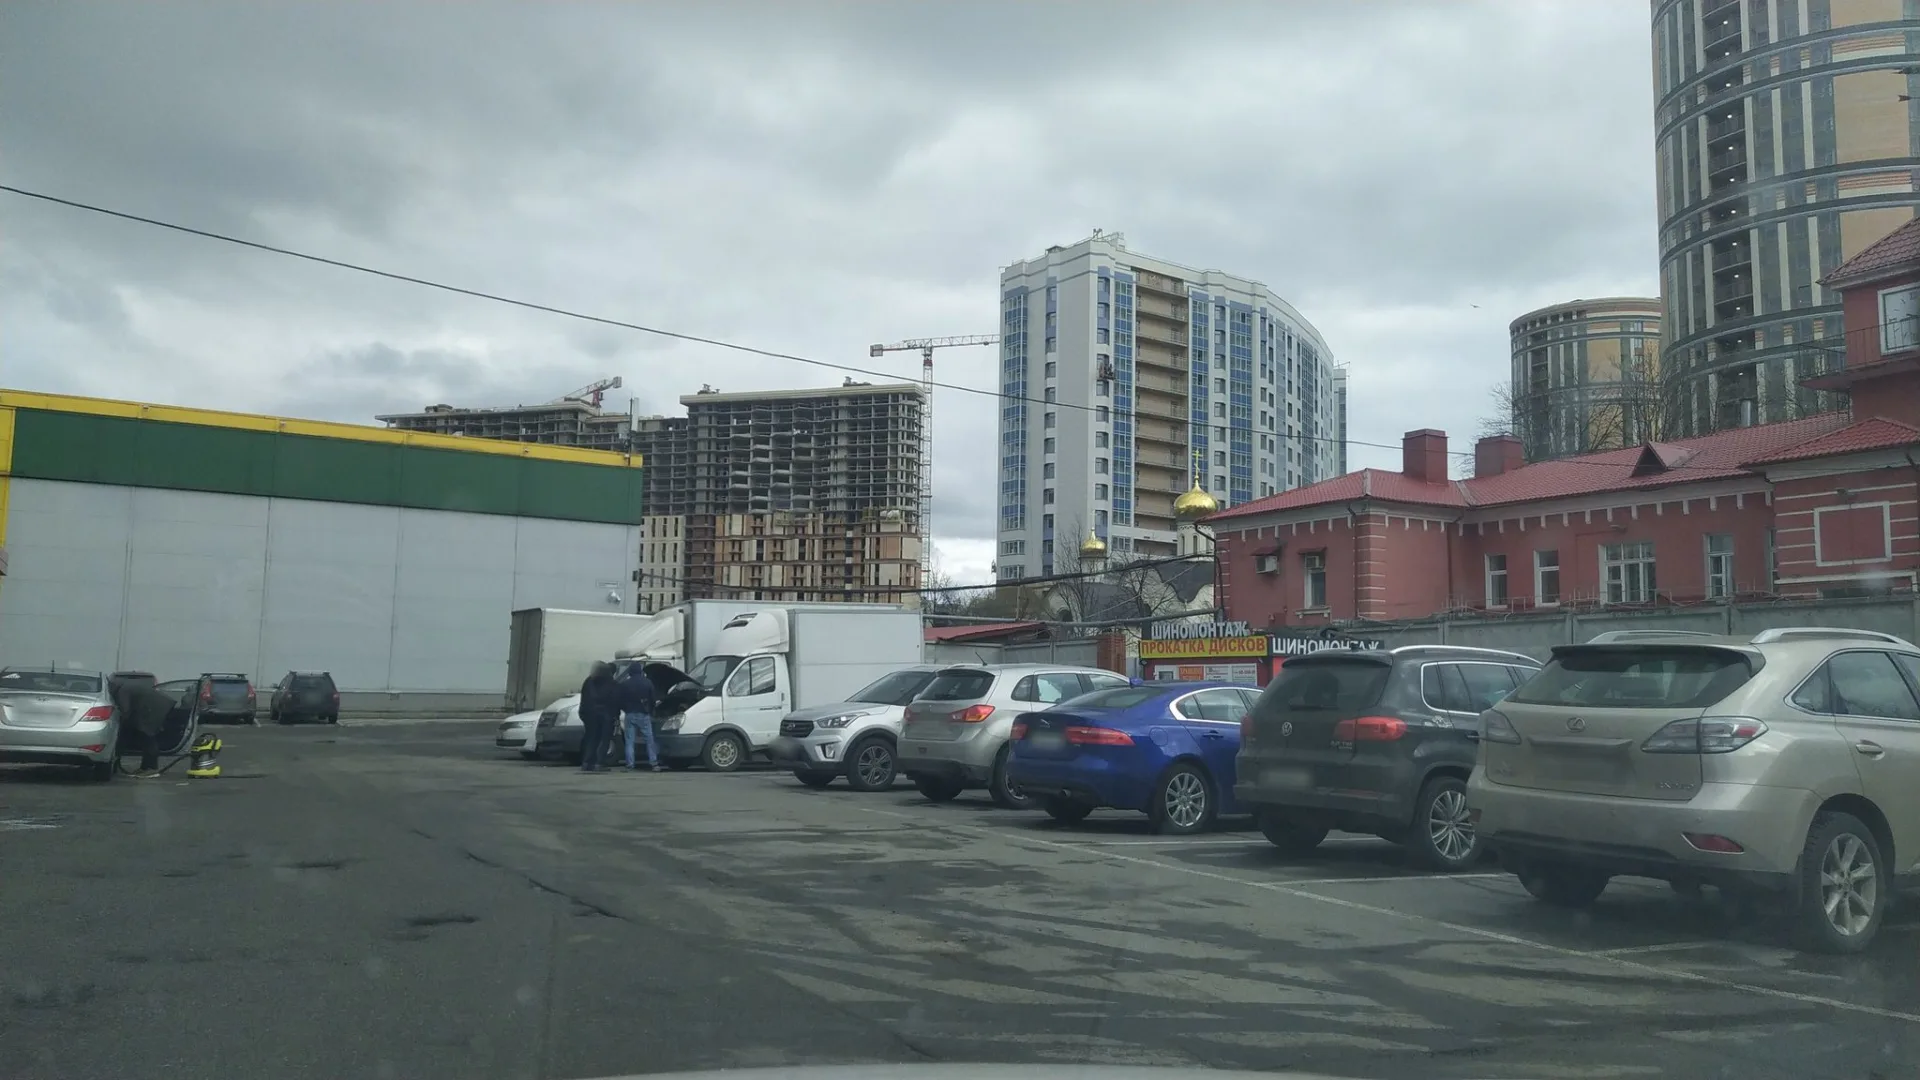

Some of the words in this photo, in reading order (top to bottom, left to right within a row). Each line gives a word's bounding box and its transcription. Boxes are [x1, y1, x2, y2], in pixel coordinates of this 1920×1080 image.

[1151, 621, 1249, 640] ШИНОМОНТАЖ
[1142, 639, 1205, 654] ПРОКАТКА
[1208, 638, 1265, 654] ДИСКОВ
